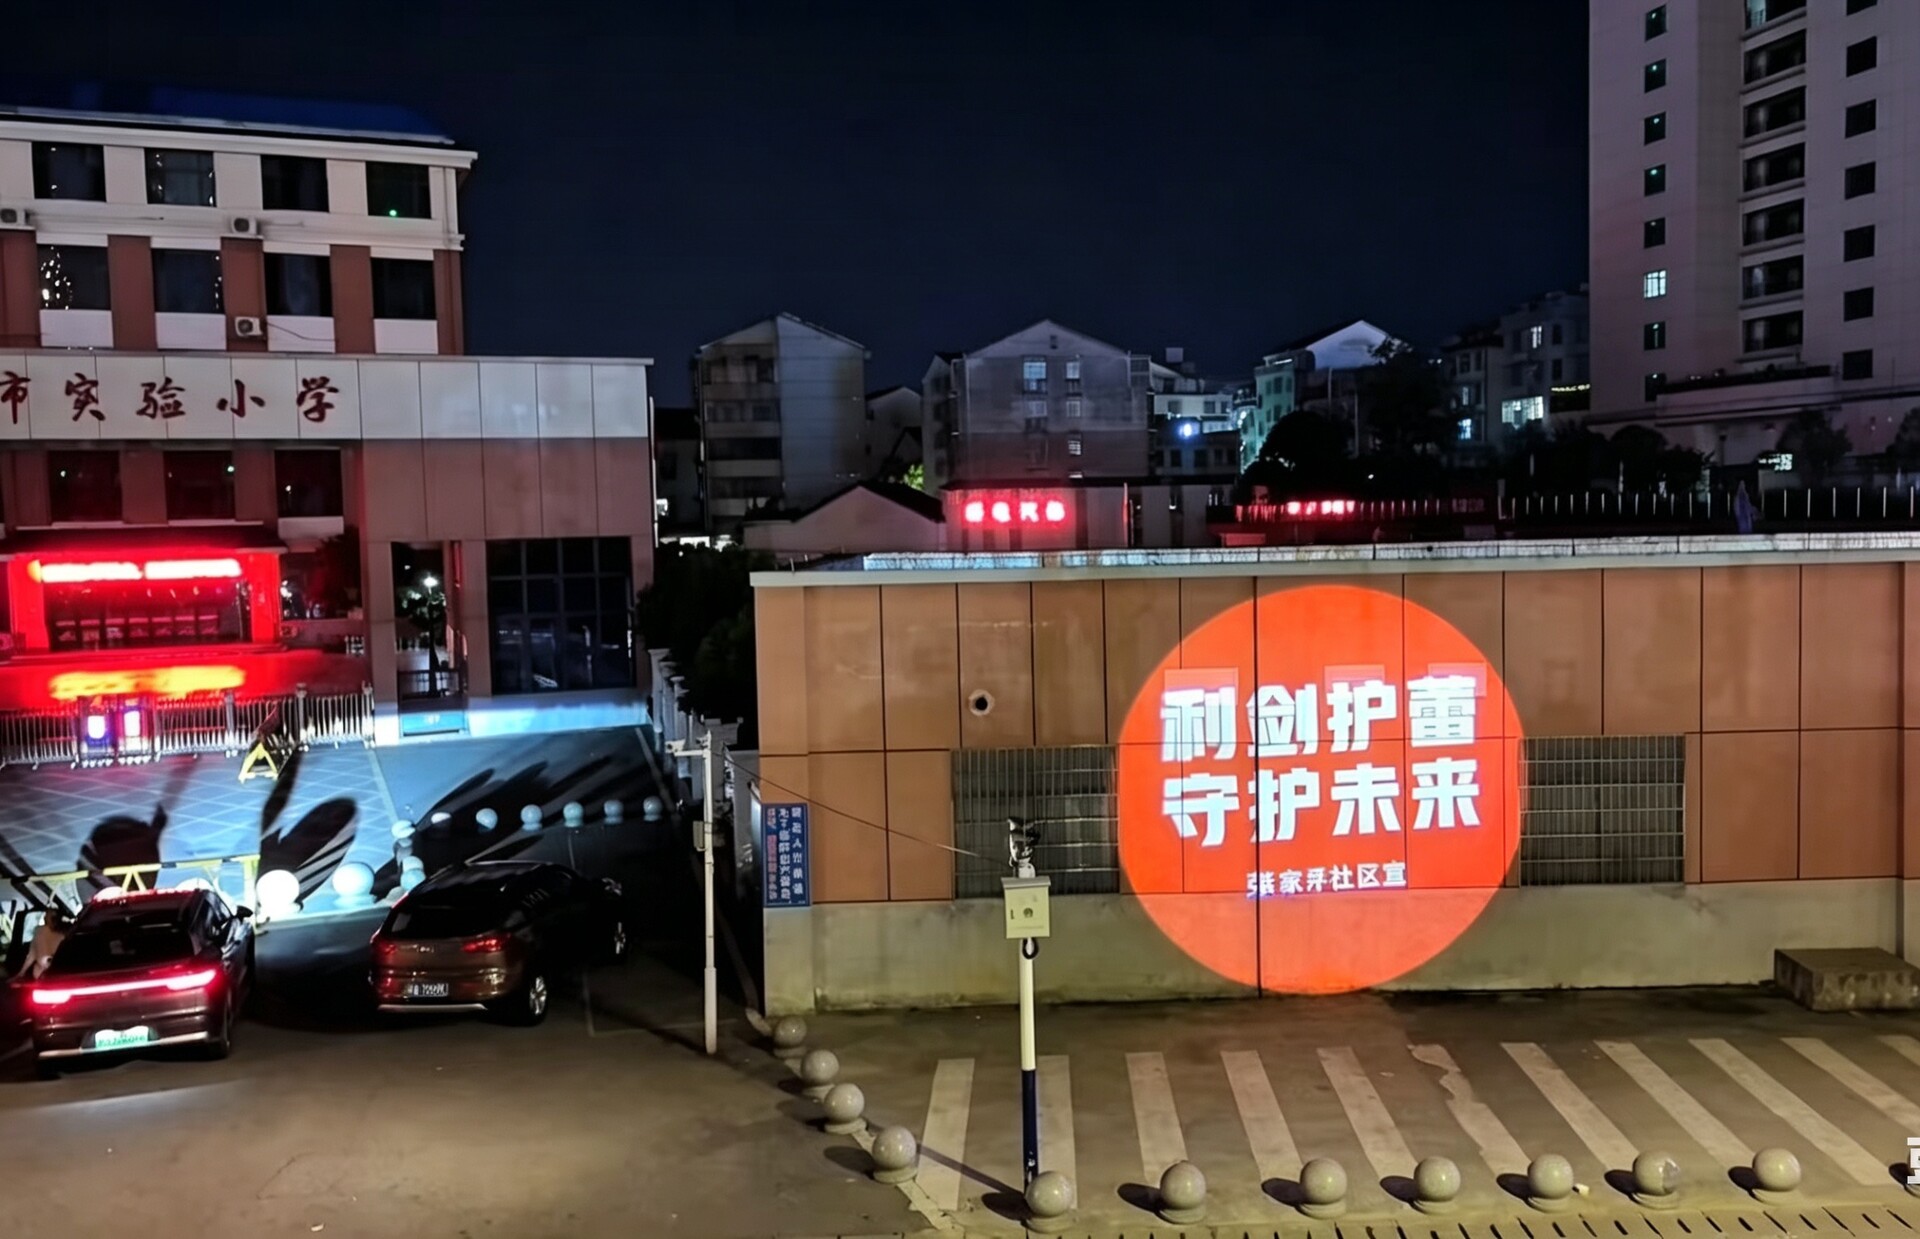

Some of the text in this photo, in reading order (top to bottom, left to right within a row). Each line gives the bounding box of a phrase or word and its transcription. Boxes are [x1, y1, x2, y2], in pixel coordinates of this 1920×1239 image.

[0, 370, 339, 425] 市实验小学
[1160, 674, 1477, 763] 利剑护蕾
[1162, 757, 1481, 848] 守护未来
